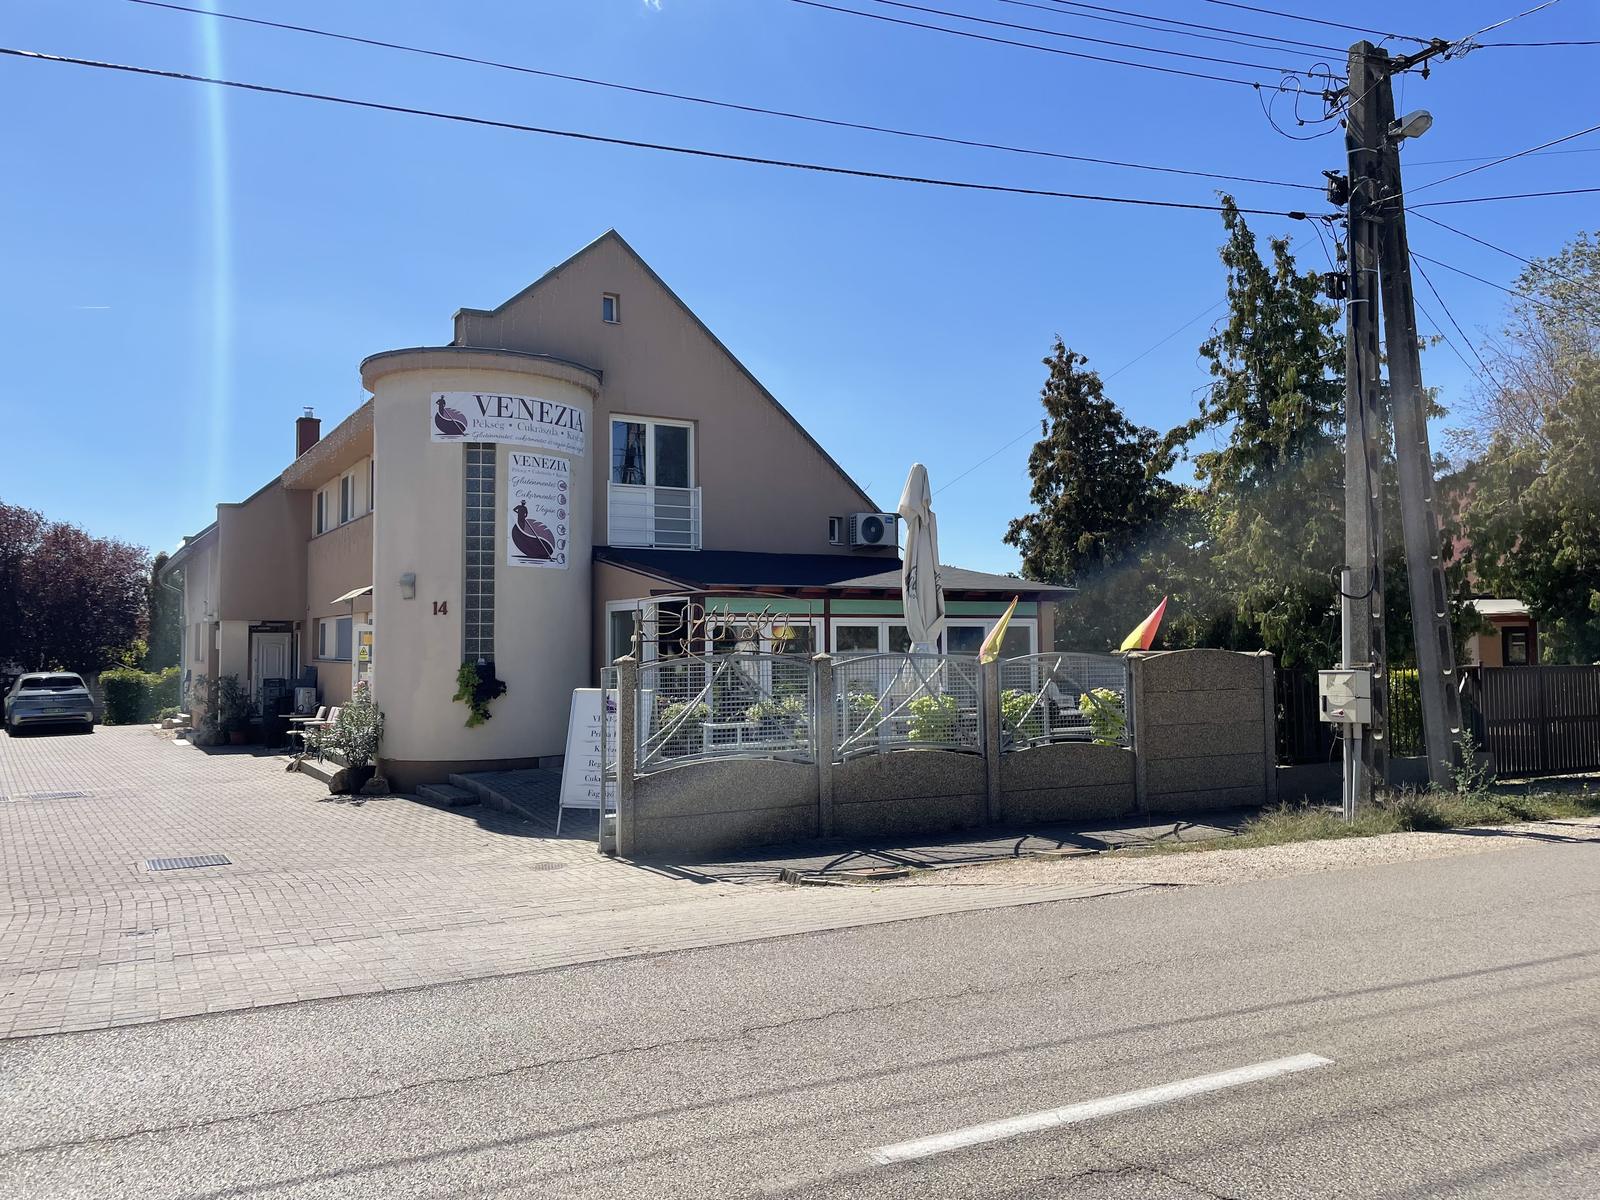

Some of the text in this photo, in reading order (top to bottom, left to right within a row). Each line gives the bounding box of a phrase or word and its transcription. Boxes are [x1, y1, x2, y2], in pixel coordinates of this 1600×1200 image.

[472, 394, 584, 432] VENEZIA
[512, 454, 567, 472] VENEZIA
[432, 600, 448, 616] 14
